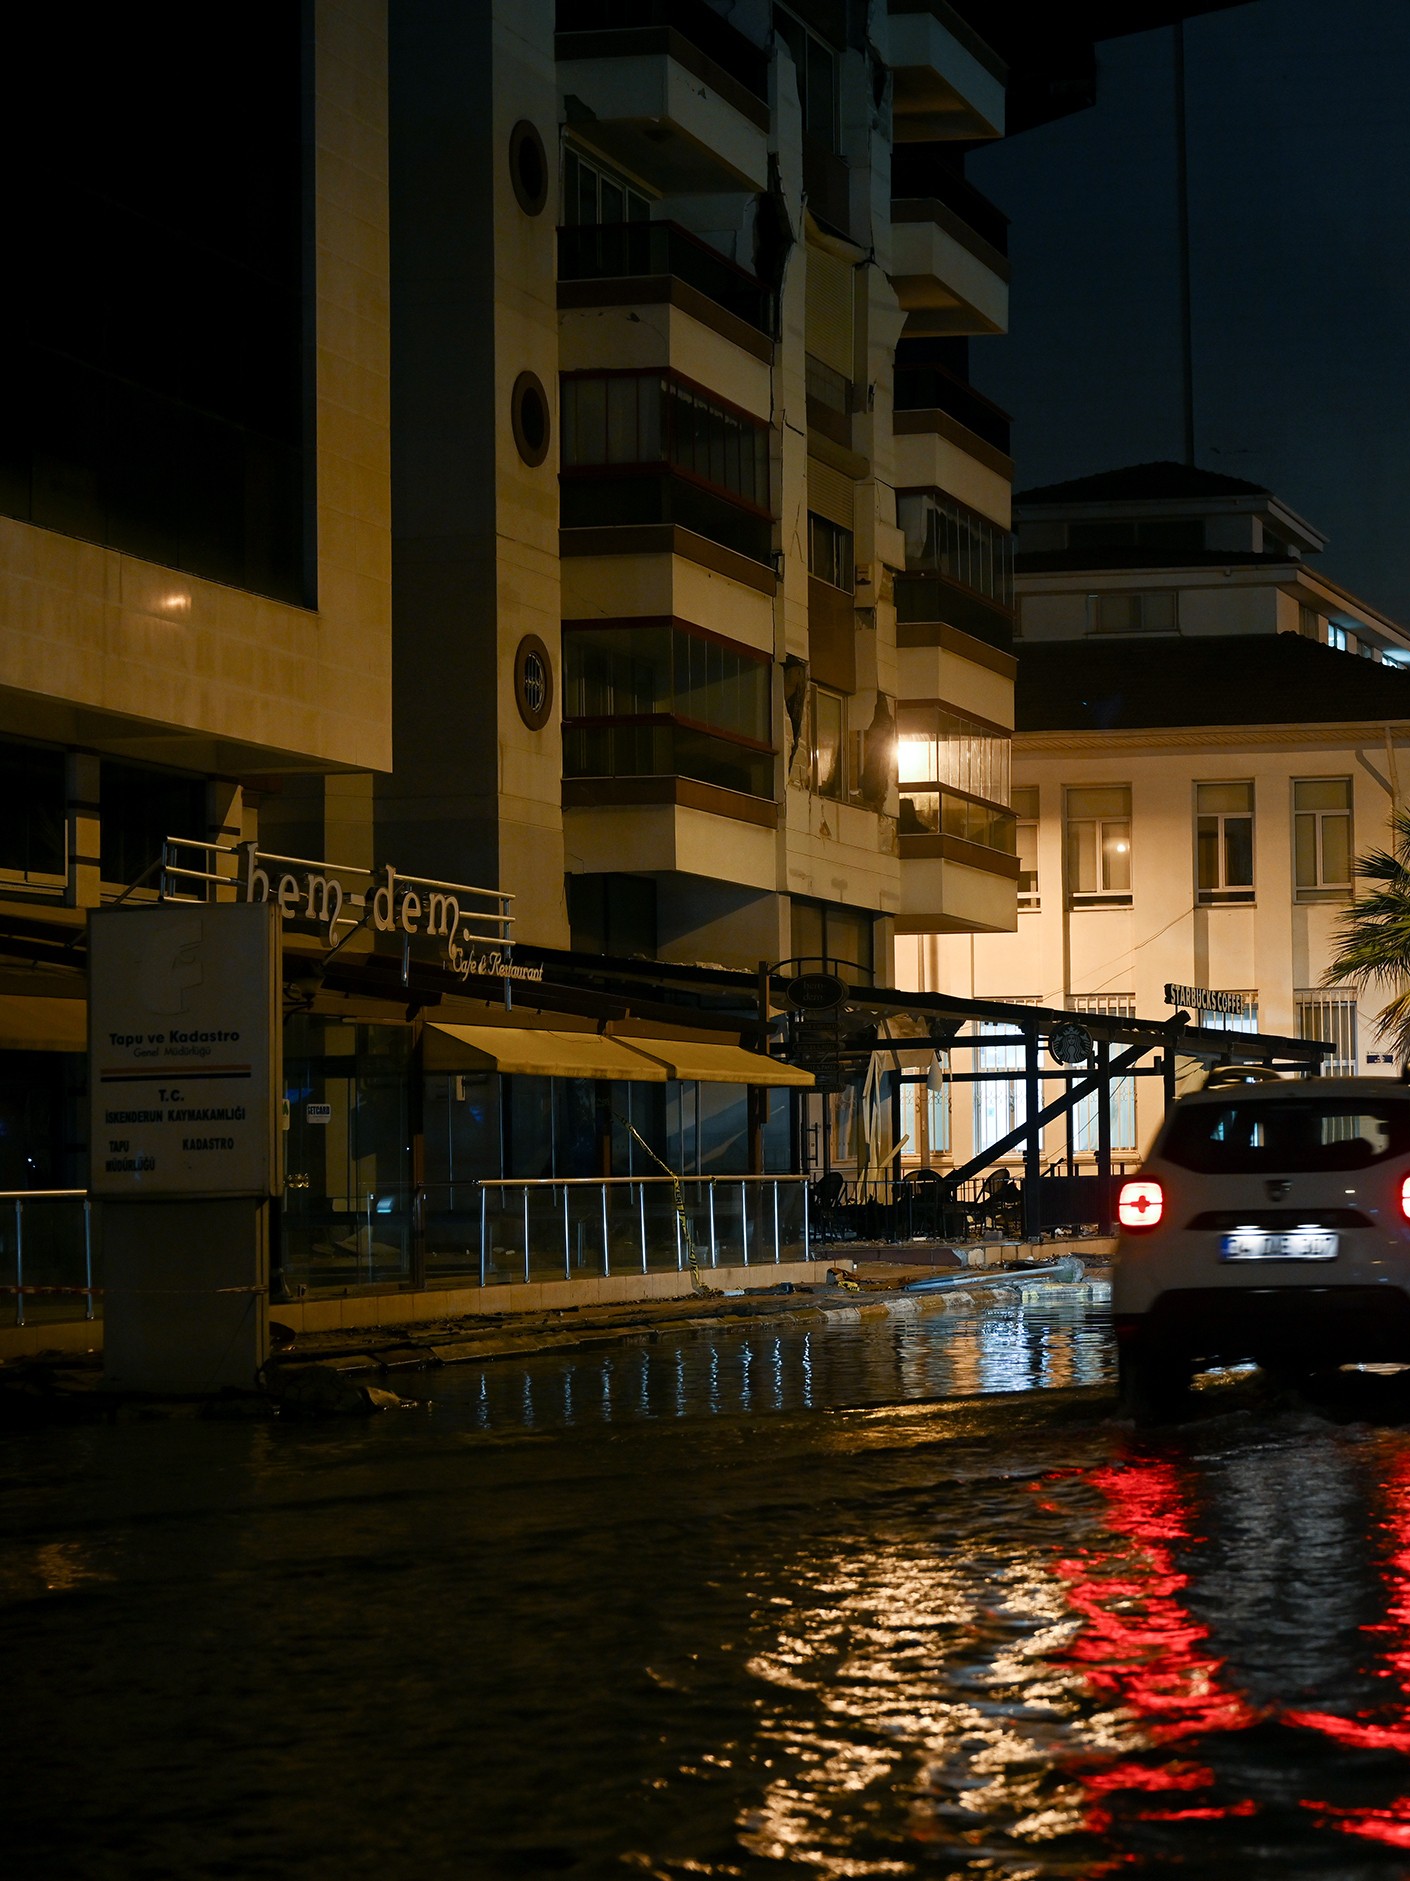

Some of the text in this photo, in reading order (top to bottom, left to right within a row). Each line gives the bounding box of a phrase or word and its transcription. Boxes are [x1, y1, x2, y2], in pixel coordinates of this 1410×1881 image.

[452, 947, 477, 982] Cafe
[488, 952, 544, 982] Restaurant
[1169, 983, 1244, 1015] STARBUCKS COFFEE
[109, 1030, 240, 1047] Tapu ve Kadastro
[133, 1046, 212, 1058] Genel Müdürlüğü
[158, 1089, 185, 1102] T.C.
[105, 1106, 246, 1124] İSKENDERUN KAYMAKAMLIĞI
[109, 1138, 234, 1153] TAPU KADASTRO
